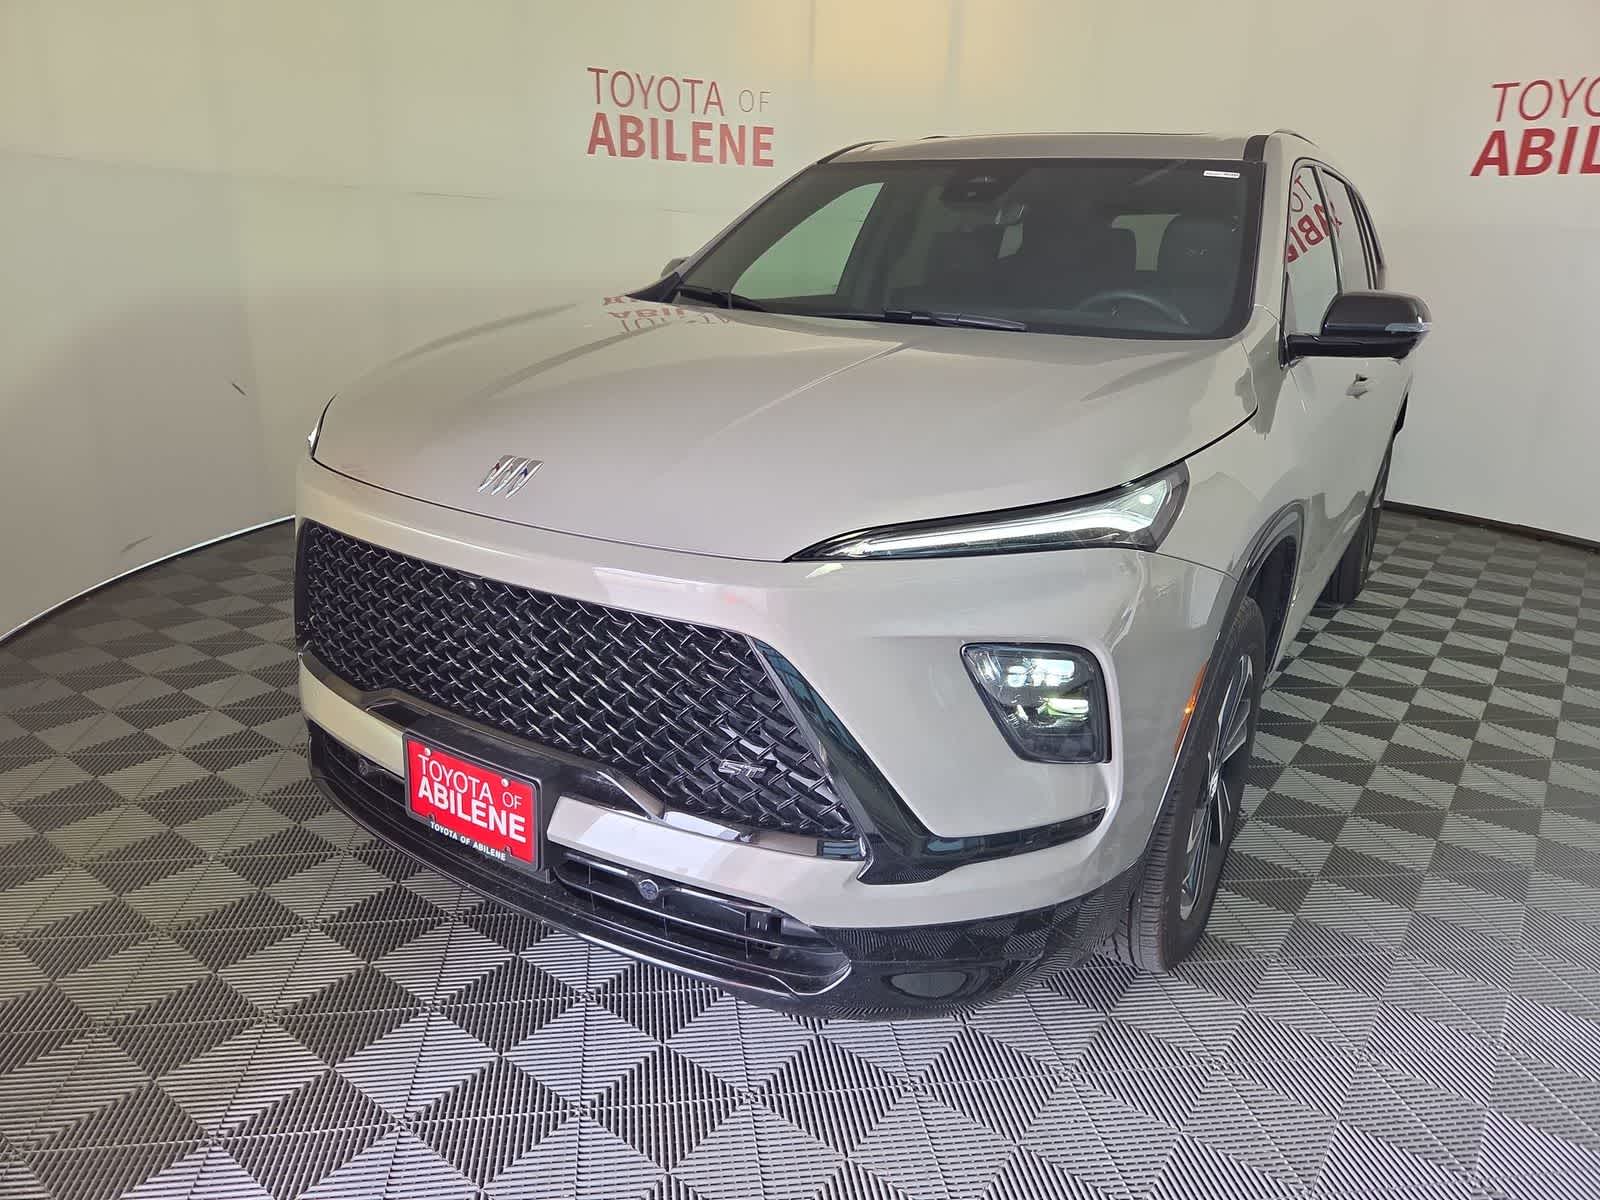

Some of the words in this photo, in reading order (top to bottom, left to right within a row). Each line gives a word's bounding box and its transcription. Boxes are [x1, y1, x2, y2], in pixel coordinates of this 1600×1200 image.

[587, 67, 725, 116] TOYOTA
[738, 89, 771, 112] OF
[587, 112, 774, 167] ABILENE
[418, 754, 494, 805] TOYOTA
[502, 791, 523, 810] OF
[418, 775, 527, 844] ABILENE
[430, 821, 458, 840] TOYOTA
[460, 835, 471, 846] OF
[472, 841, 506, 861] ABILENE
